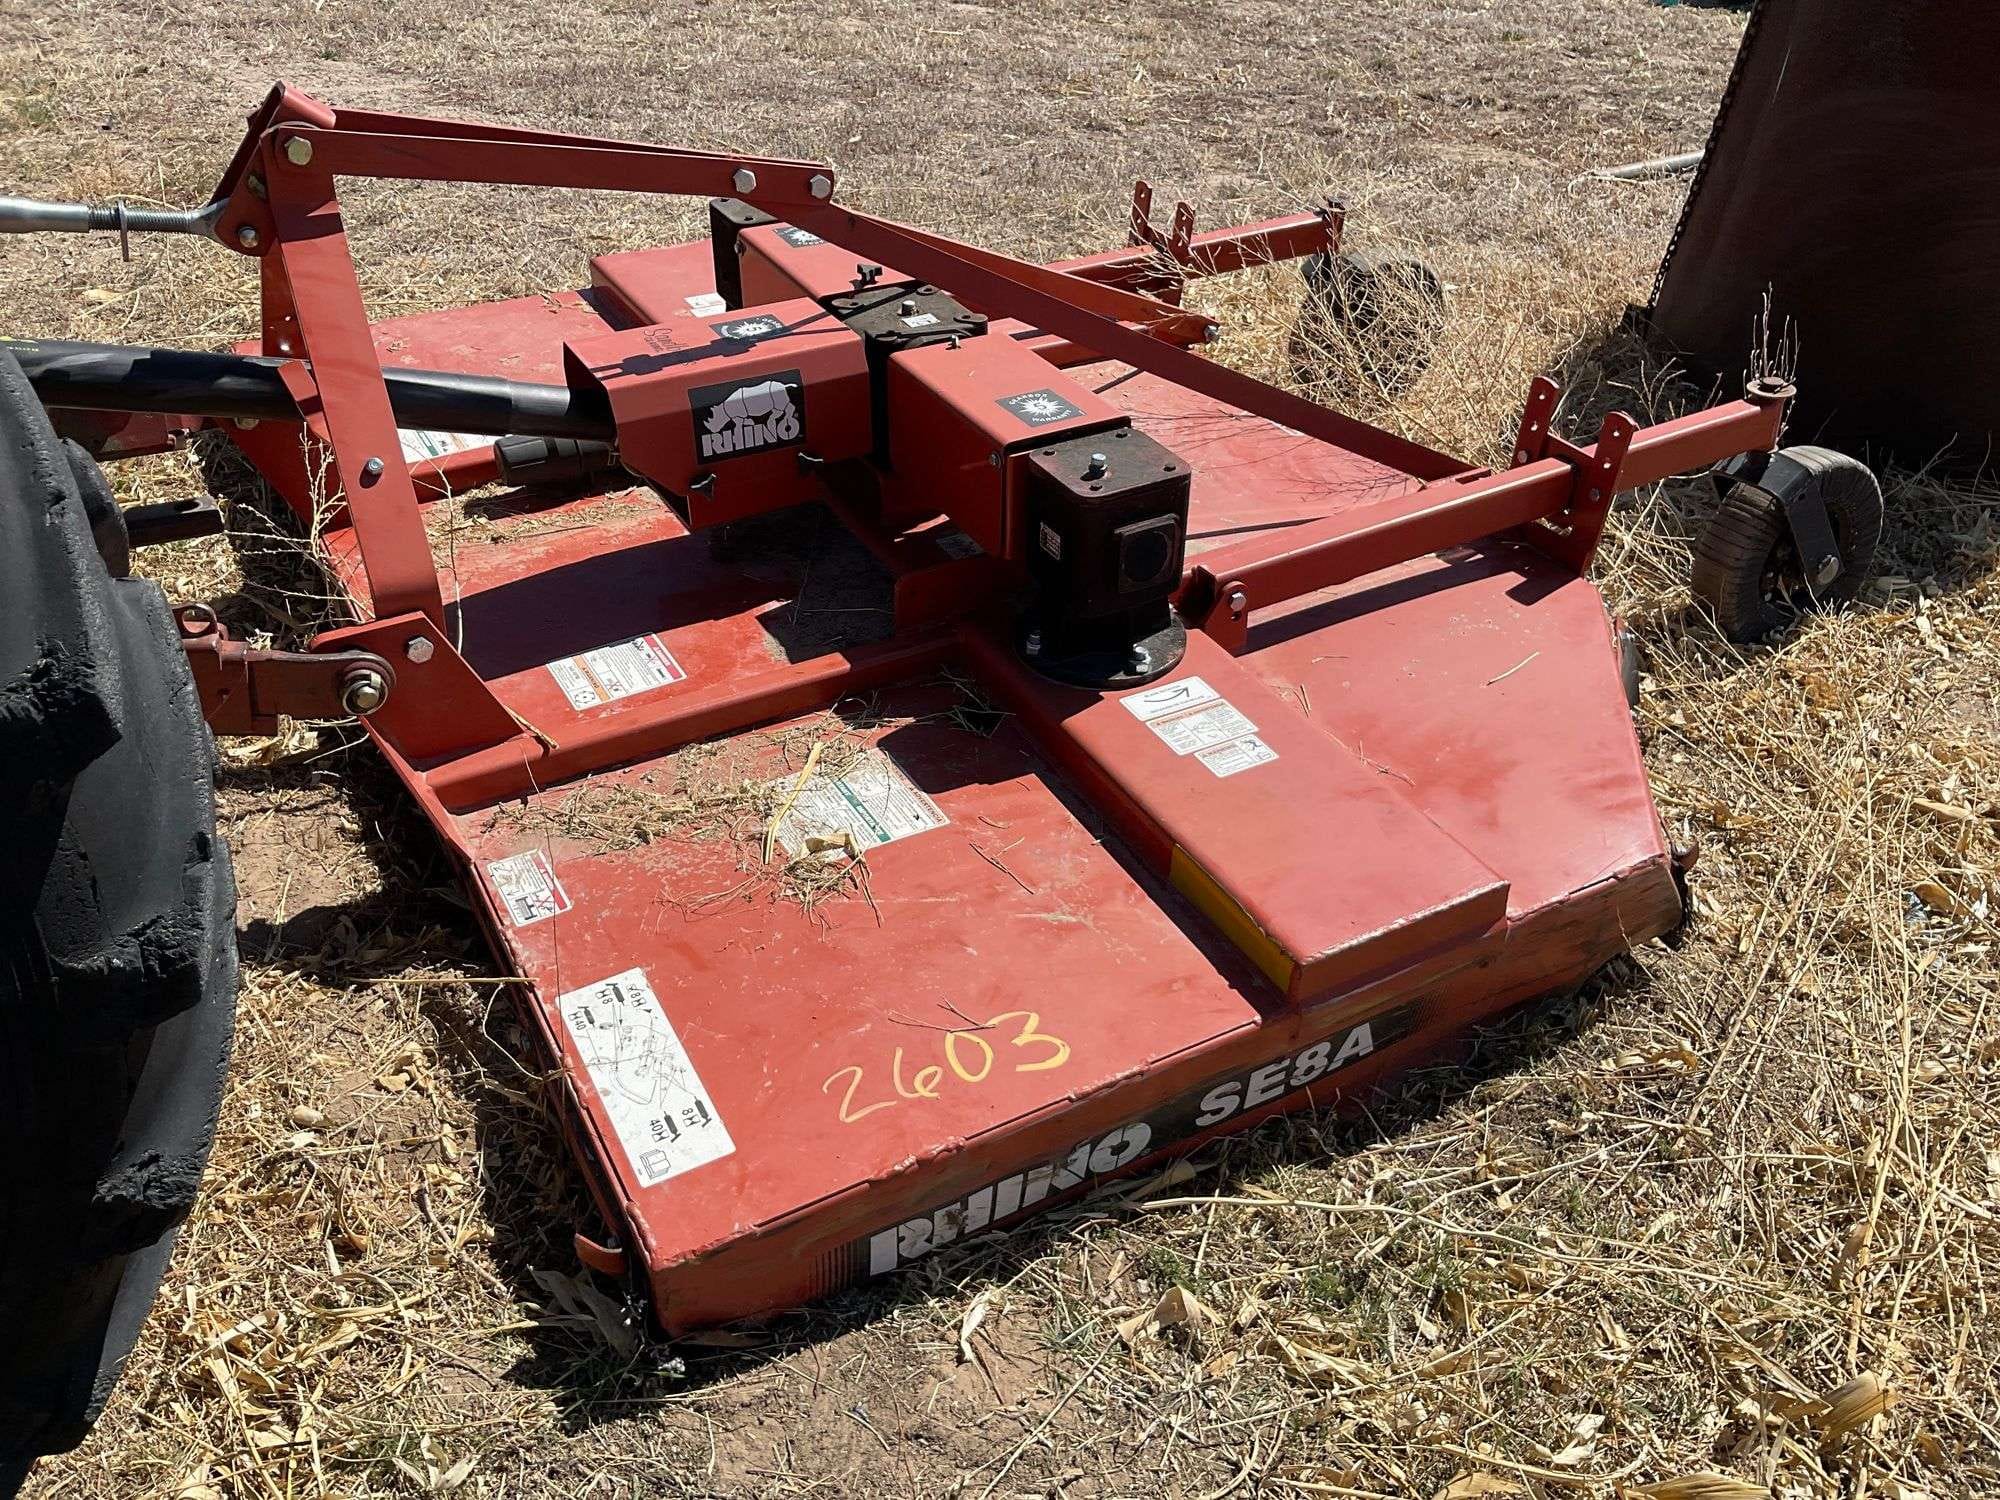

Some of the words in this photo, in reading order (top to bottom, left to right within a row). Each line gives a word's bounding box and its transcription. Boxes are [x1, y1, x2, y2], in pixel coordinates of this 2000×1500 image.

[822, 1010, 1072, 1123] 2603
[869, 1121, 1152, 1277] RHINO
[1196, 1021, 1374, 1126] SE8A
